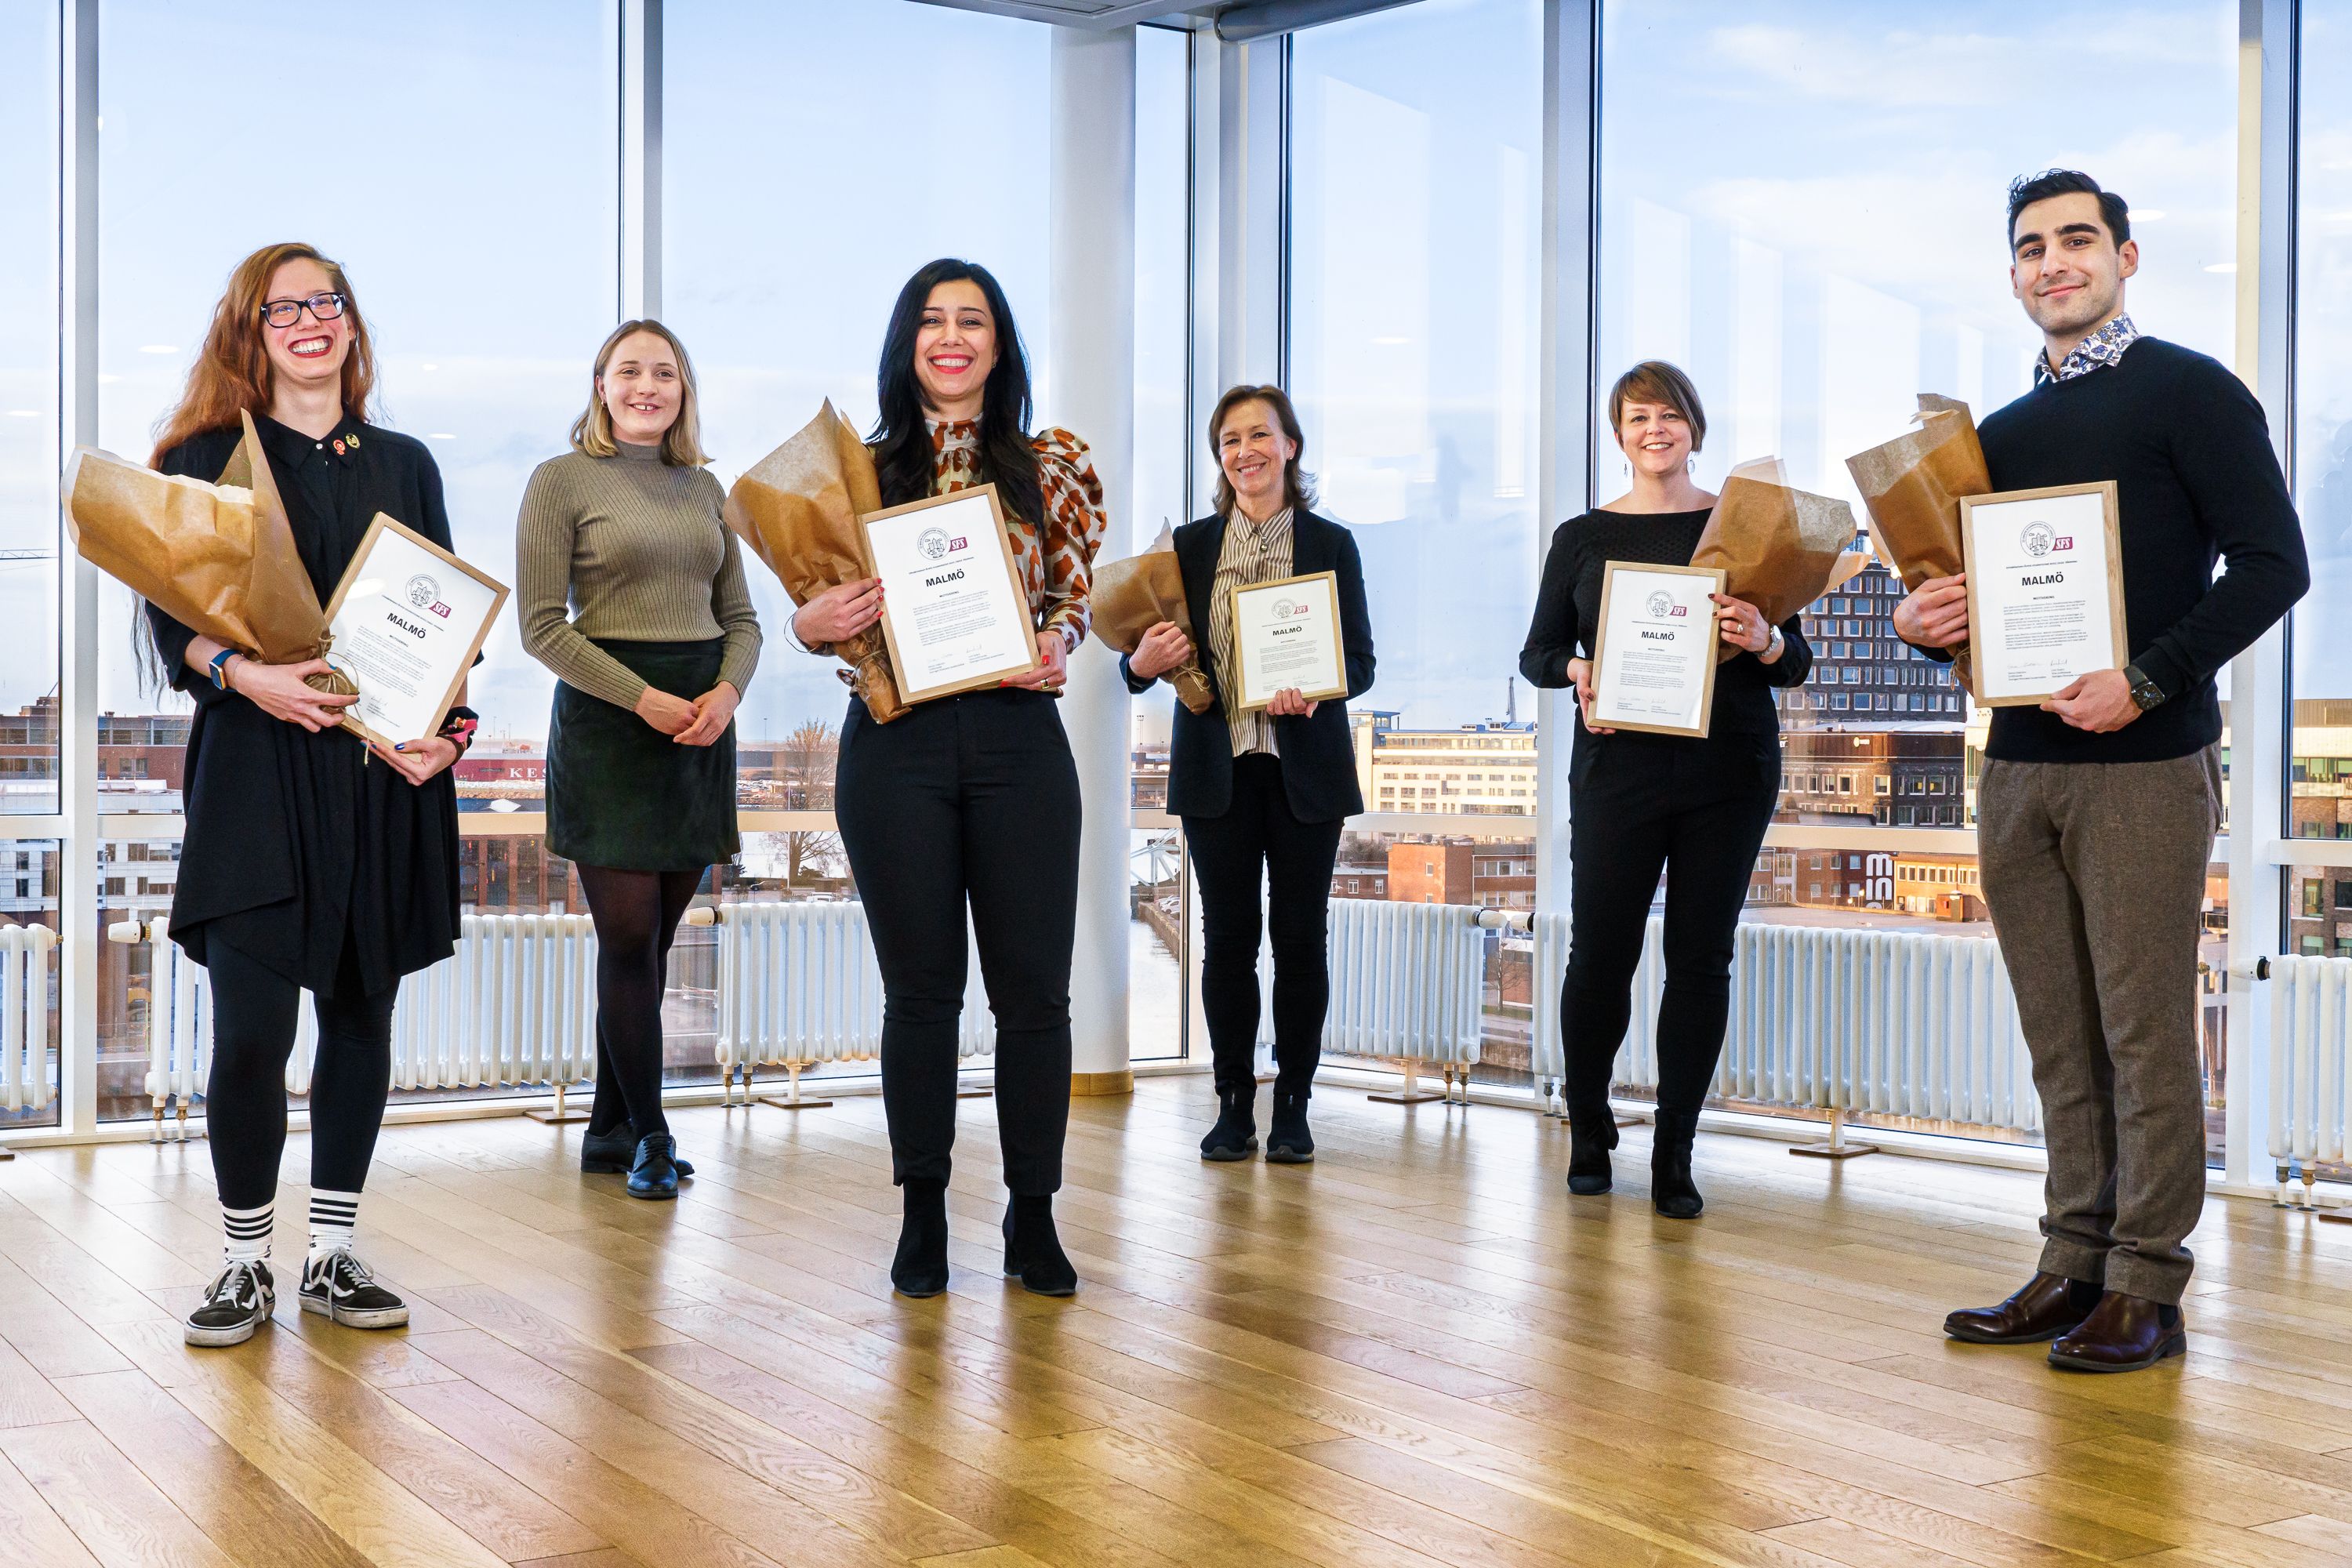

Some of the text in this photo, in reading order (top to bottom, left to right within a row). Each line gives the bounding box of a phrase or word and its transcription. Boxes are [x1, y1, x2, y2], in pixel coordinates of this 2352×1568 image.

[951, 538, 965, 550] SFS
[2056, 538, 2071, 550] SFS
[925, 568, 965, 587] MALMÖ
[2022, 572, 2063, 586] MALMÖ
[433, 603, 449, 616] SFS
[1673, 607, 1686, 615] SFS
[387, 612, 426, 640] MALMÖ
[1272, 626, 1302, 636] MALMÖ
[1641, 631, 1675, 641] MALMÖ
